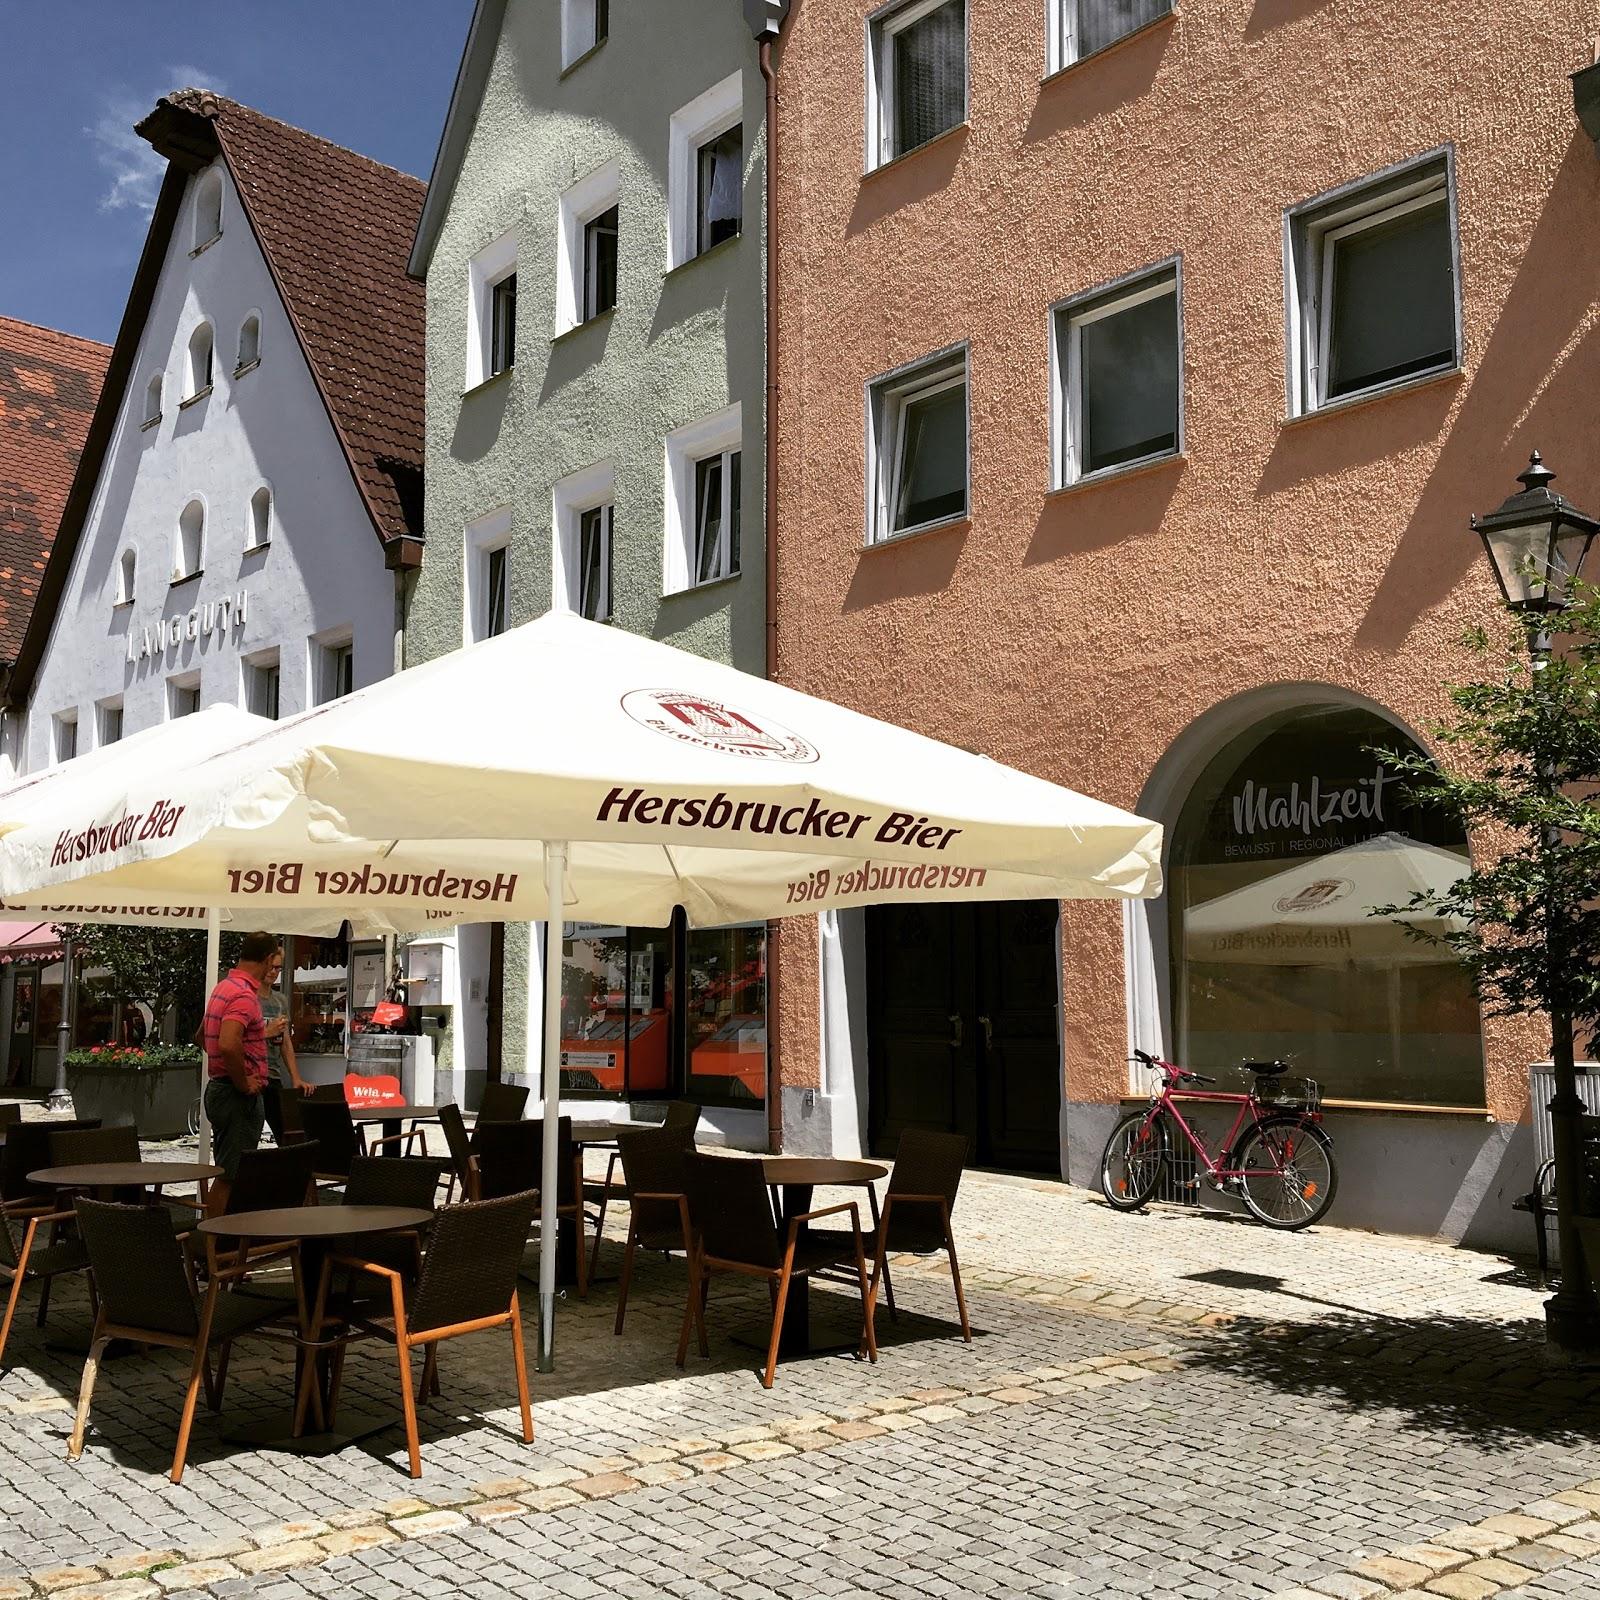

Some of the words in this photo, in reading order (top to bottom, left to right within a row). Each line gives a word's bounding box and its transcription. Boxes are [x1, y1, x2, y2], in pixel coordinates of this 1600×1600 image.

[127, 589, 247, 664] LANGGUTH
[138, 799, 185, 840] Bier
[596, 787, 871, 839] Hersbrucker
[874, 812, 962, 850] Bier
[1233, 766, 1404, 835] Mahlzeit
[1225, 841, 1275, 857] BEWUSST
[1289, 836, 1347, 851] REGIONAL
